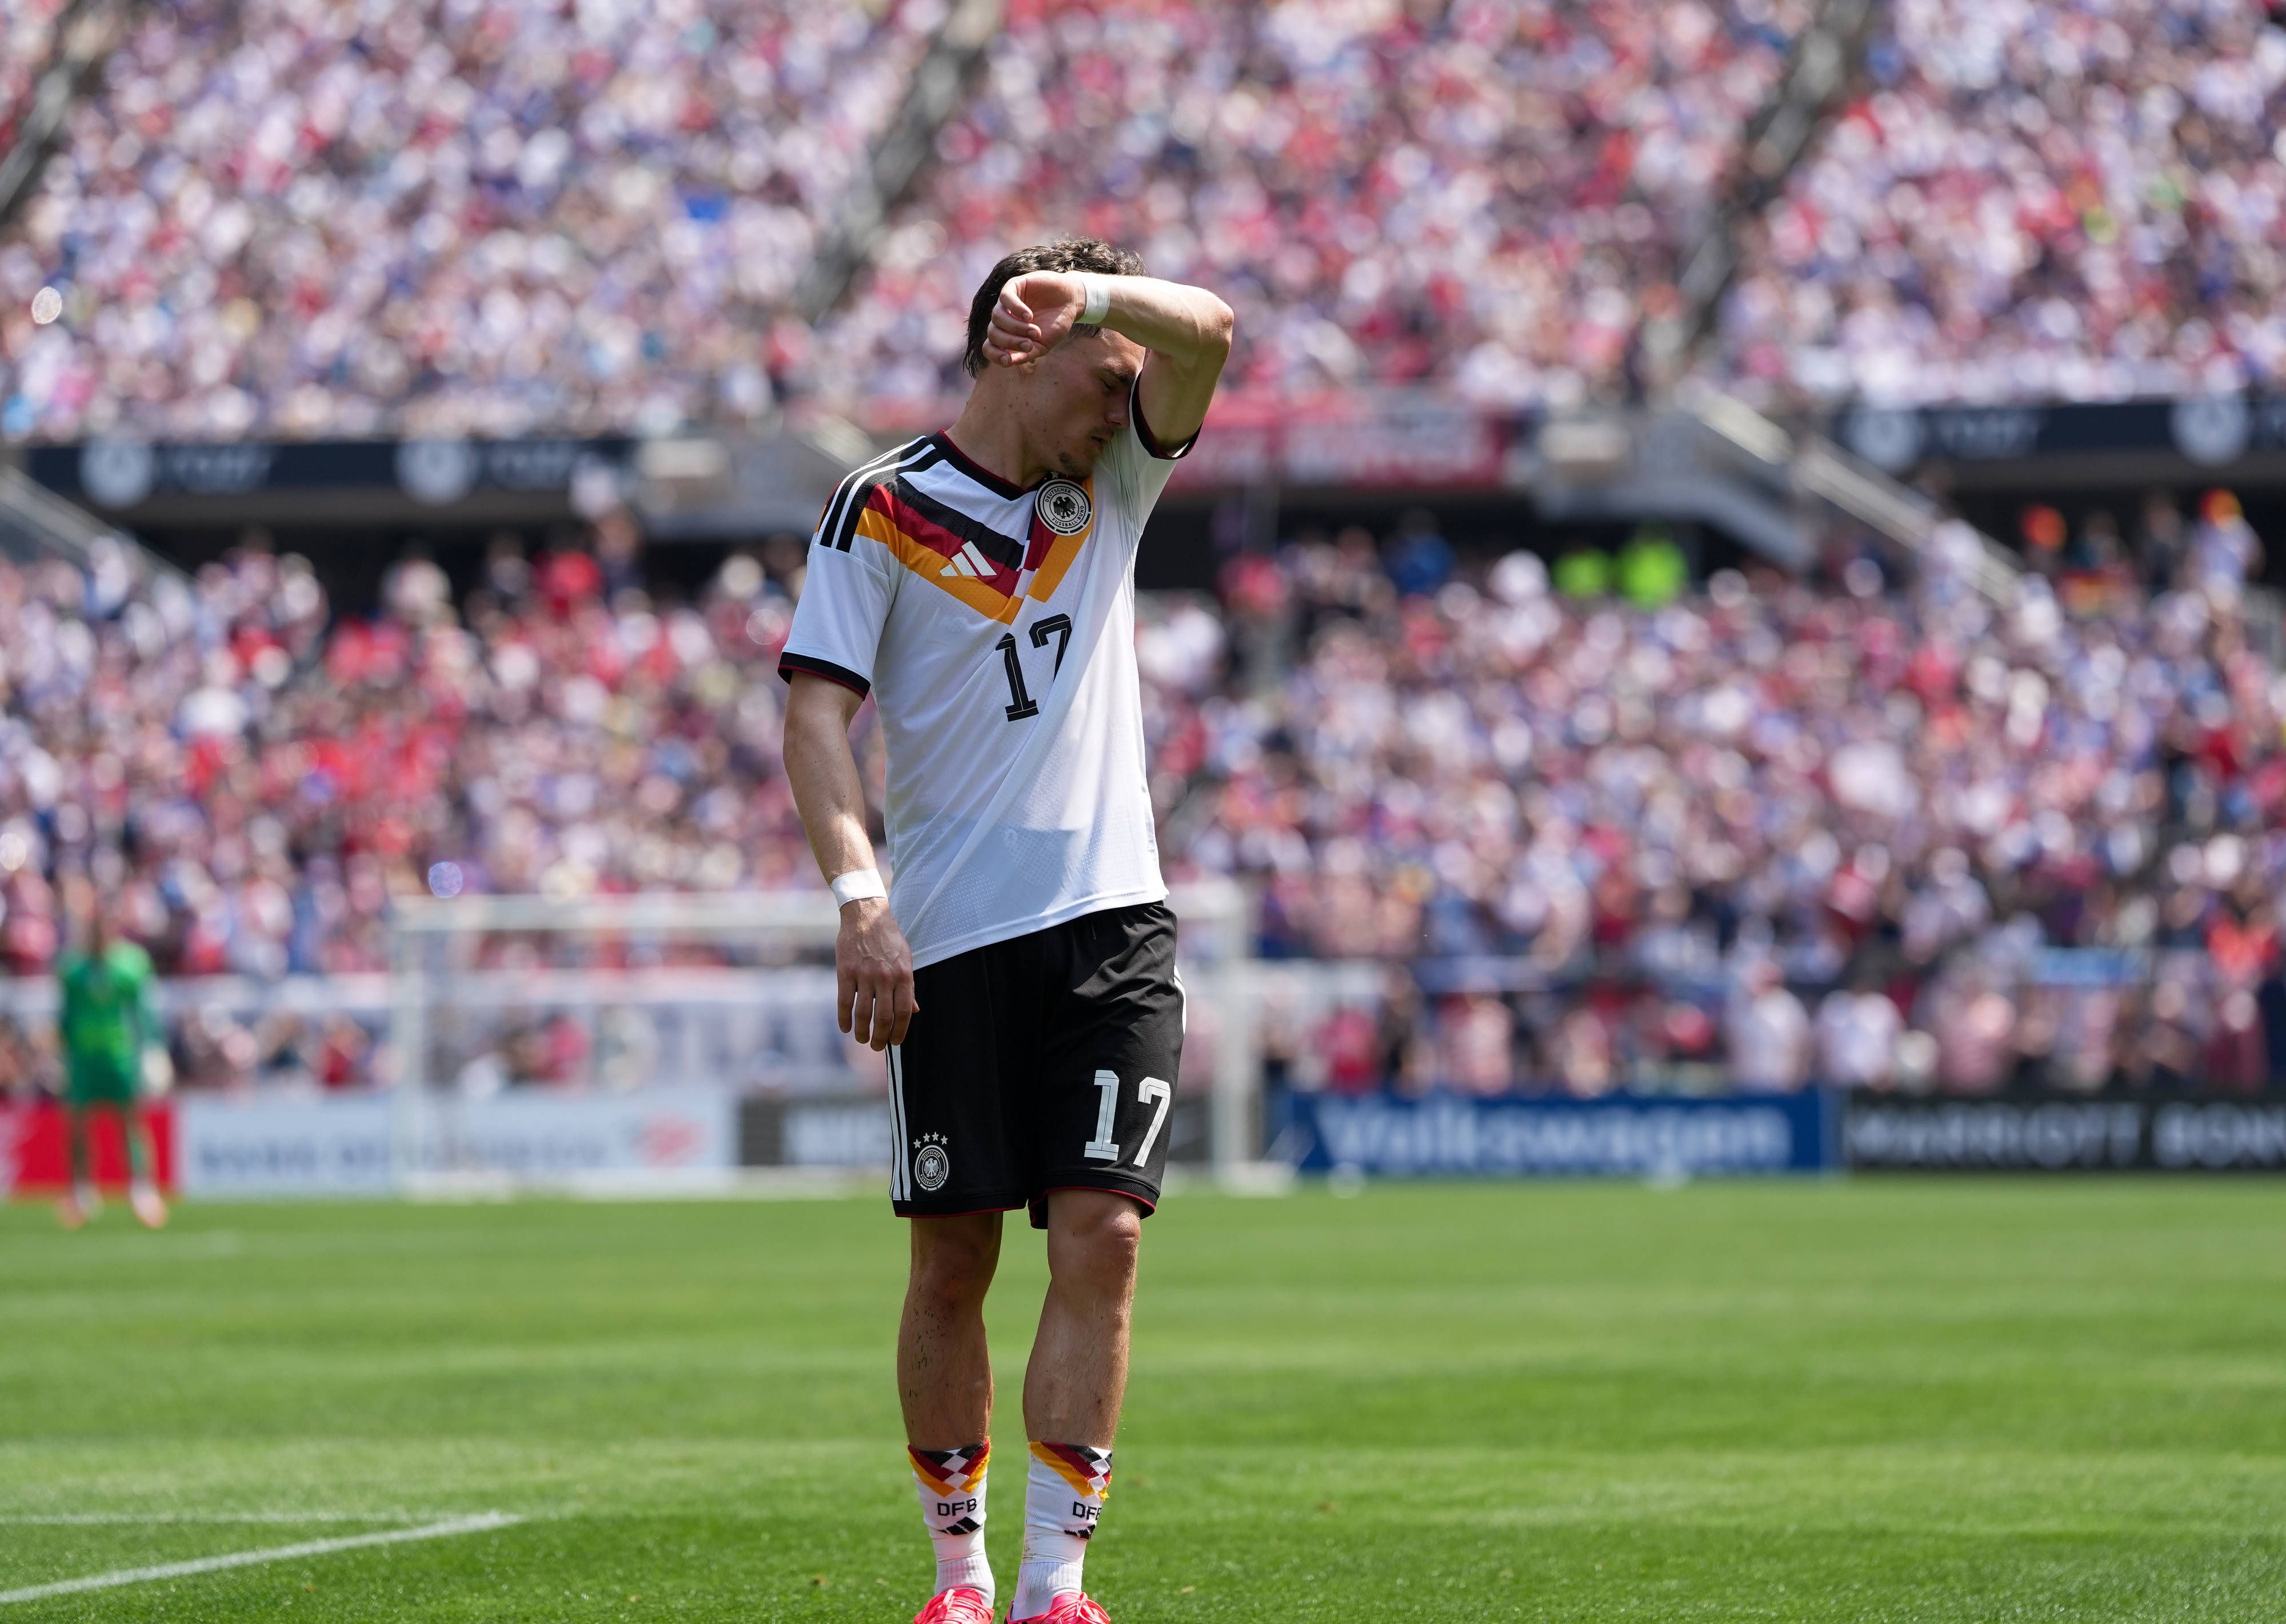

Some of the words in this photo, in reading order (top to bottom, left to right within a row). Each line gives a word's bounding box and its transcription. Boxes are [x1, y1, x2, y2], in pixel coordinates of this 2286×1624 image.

[1045, 487, 1071, 503] DEUTSCHER
[1052, 505, 1085, 527] FUSSBALL-BUND
[995, 613, 1073, 722] 17
[1084, 1069, 1171, 1168] 17
[1317, 1095, 1793, 1176] Volkswagen
[921, 1151, 941, 1161] DEUTSCHER
[920, 1170, 944, 1185] FUSSBALL-BUND
[937, 1498, 977, 1517] DFB
